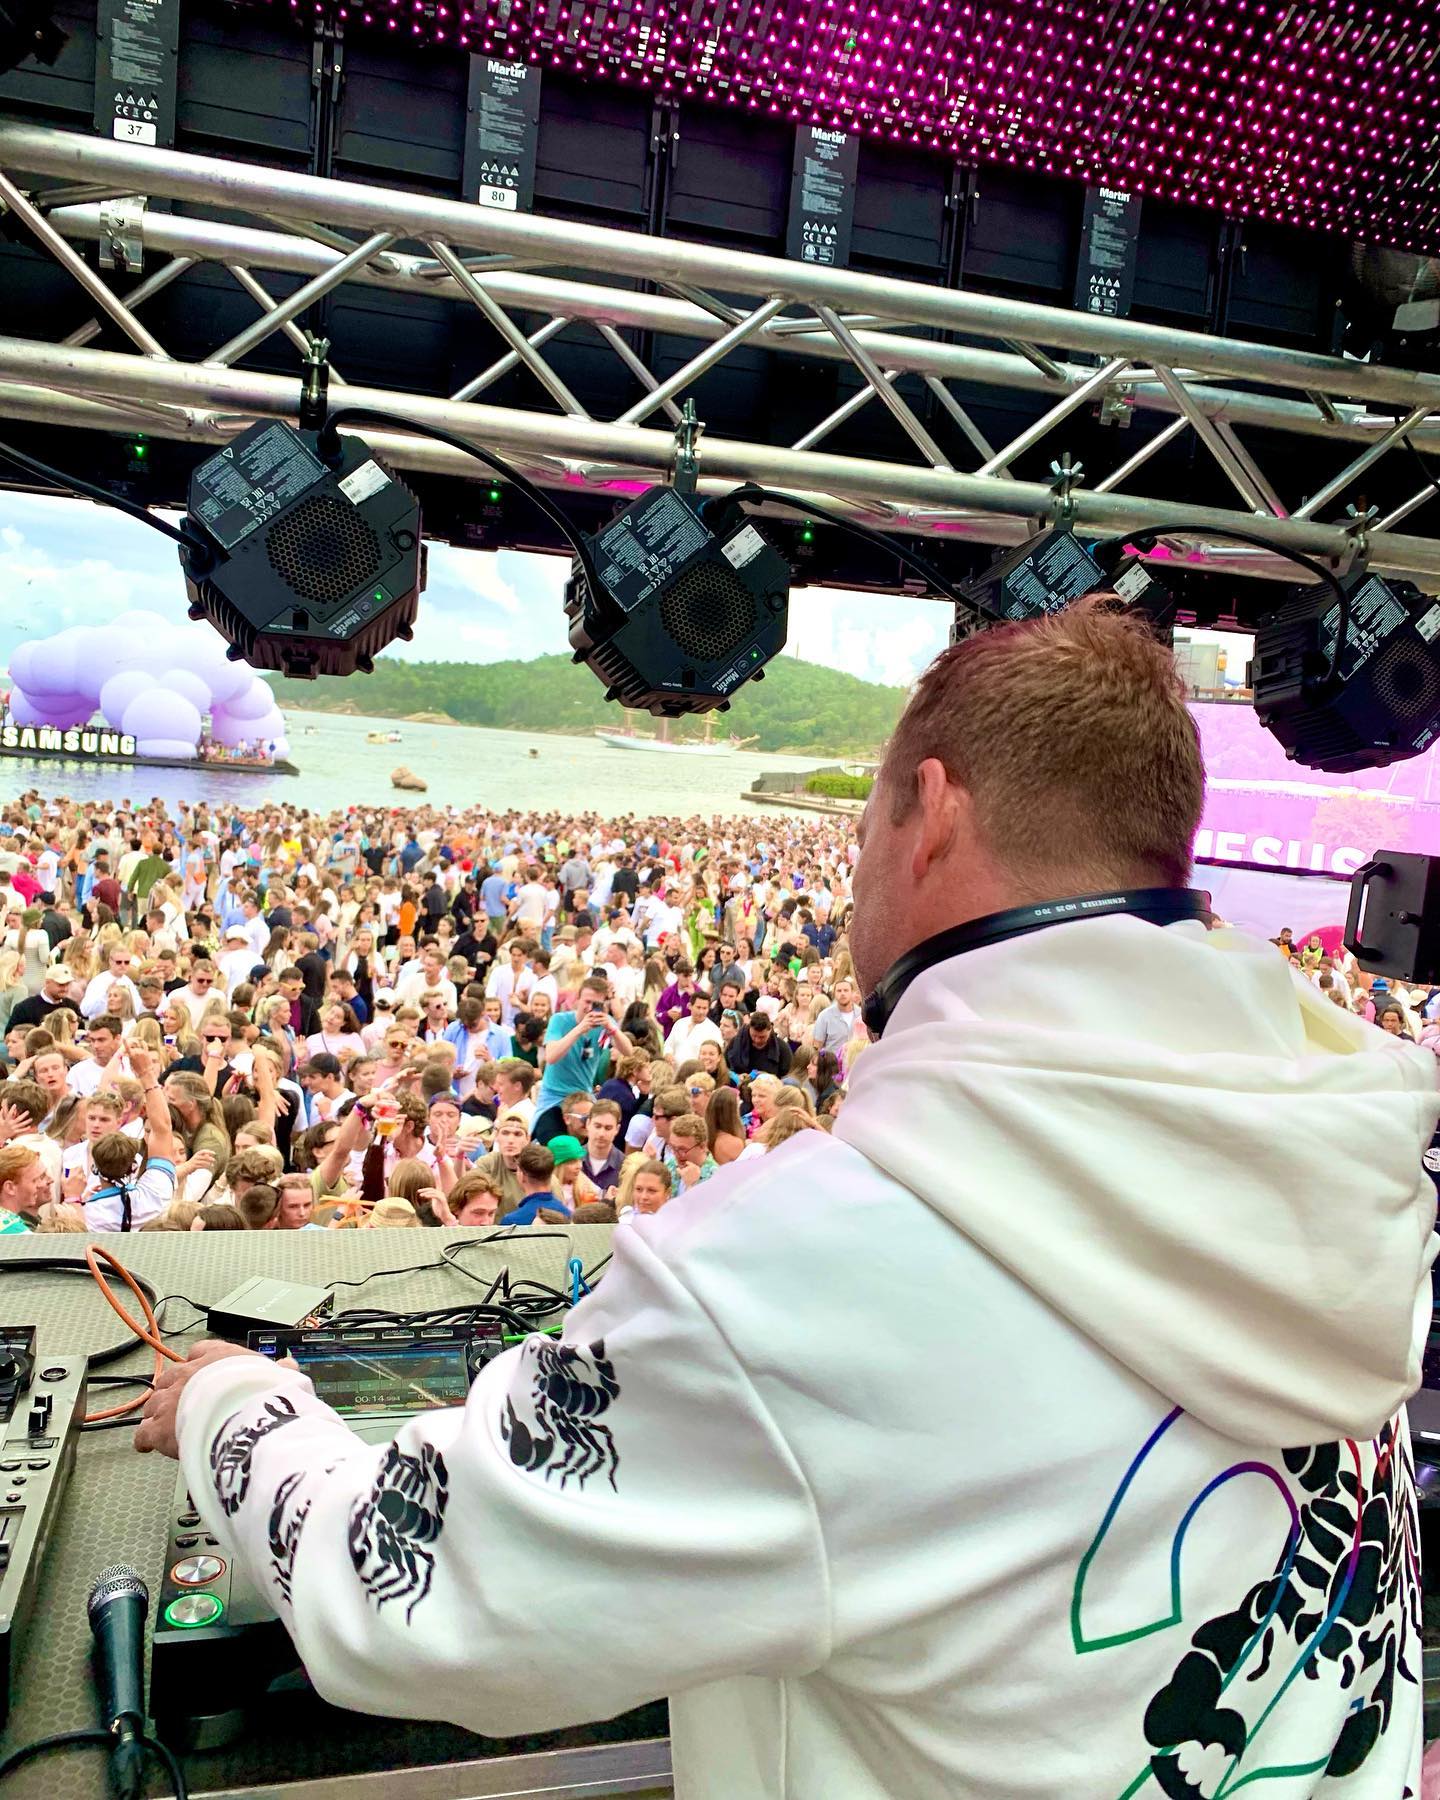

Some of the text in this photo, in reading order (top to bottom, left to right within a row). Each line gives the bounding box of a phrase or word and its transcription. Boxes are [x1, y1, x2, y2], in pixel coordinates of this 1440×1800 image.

[487, 60, 527, 79] Martin
[127, 124, 142, 136] 37
[811, 127, 846, 144] Martin
[491, 191, 505, 202] 80
[1099, 187, 1131, 202] Martin
[716, 671, 739, 694] Martin
[3, 727, 135, 755] SAMSUNG
